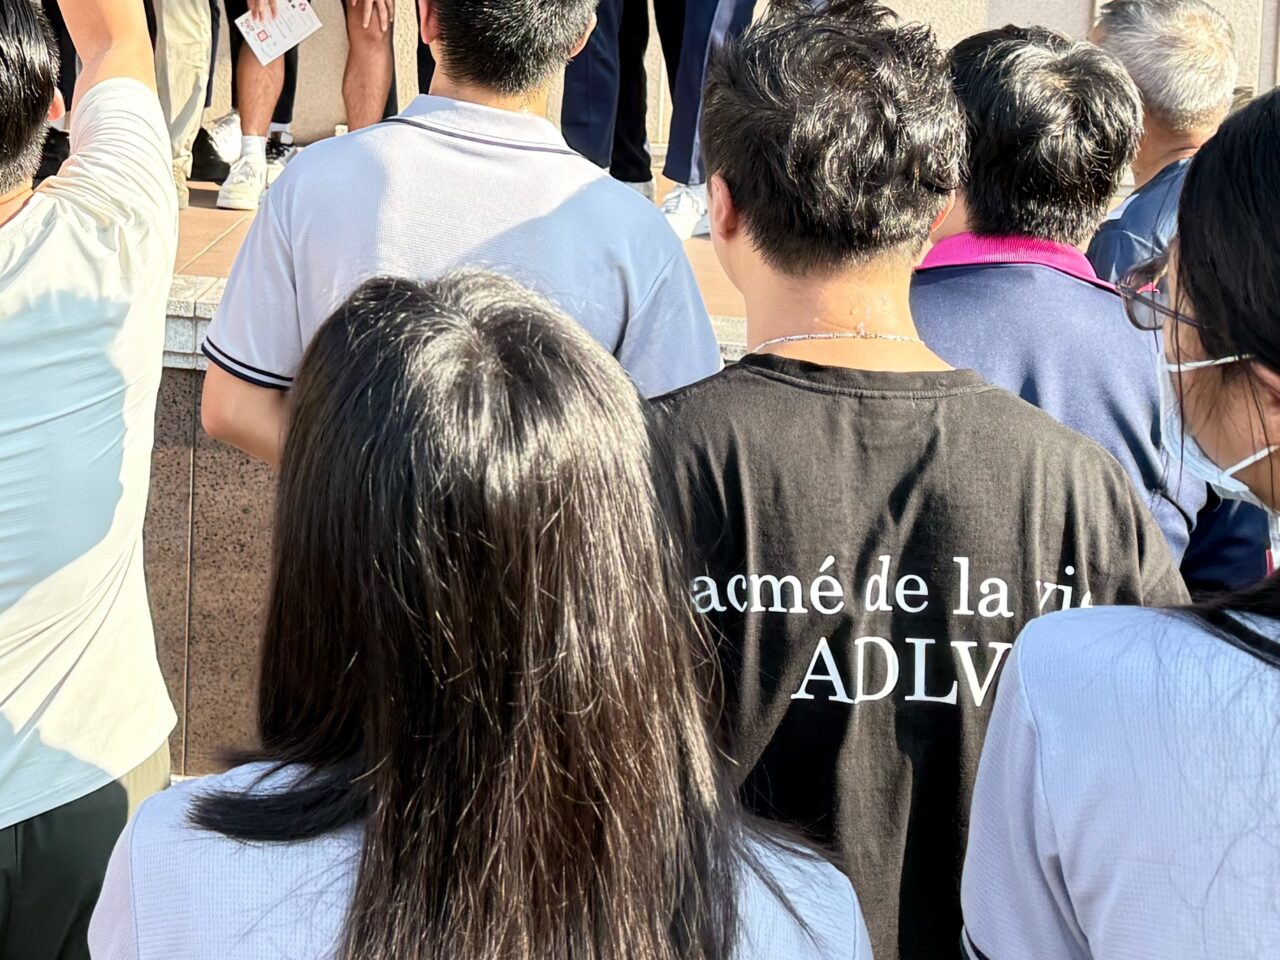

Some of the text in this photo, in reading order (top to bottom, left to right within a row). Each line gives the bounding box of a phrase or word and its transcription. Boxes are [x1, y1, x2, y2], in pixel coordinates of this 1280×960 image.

[691, 555, 1093, 618] acmé de la vi
[790, 636, 1013, 707] ADLV
